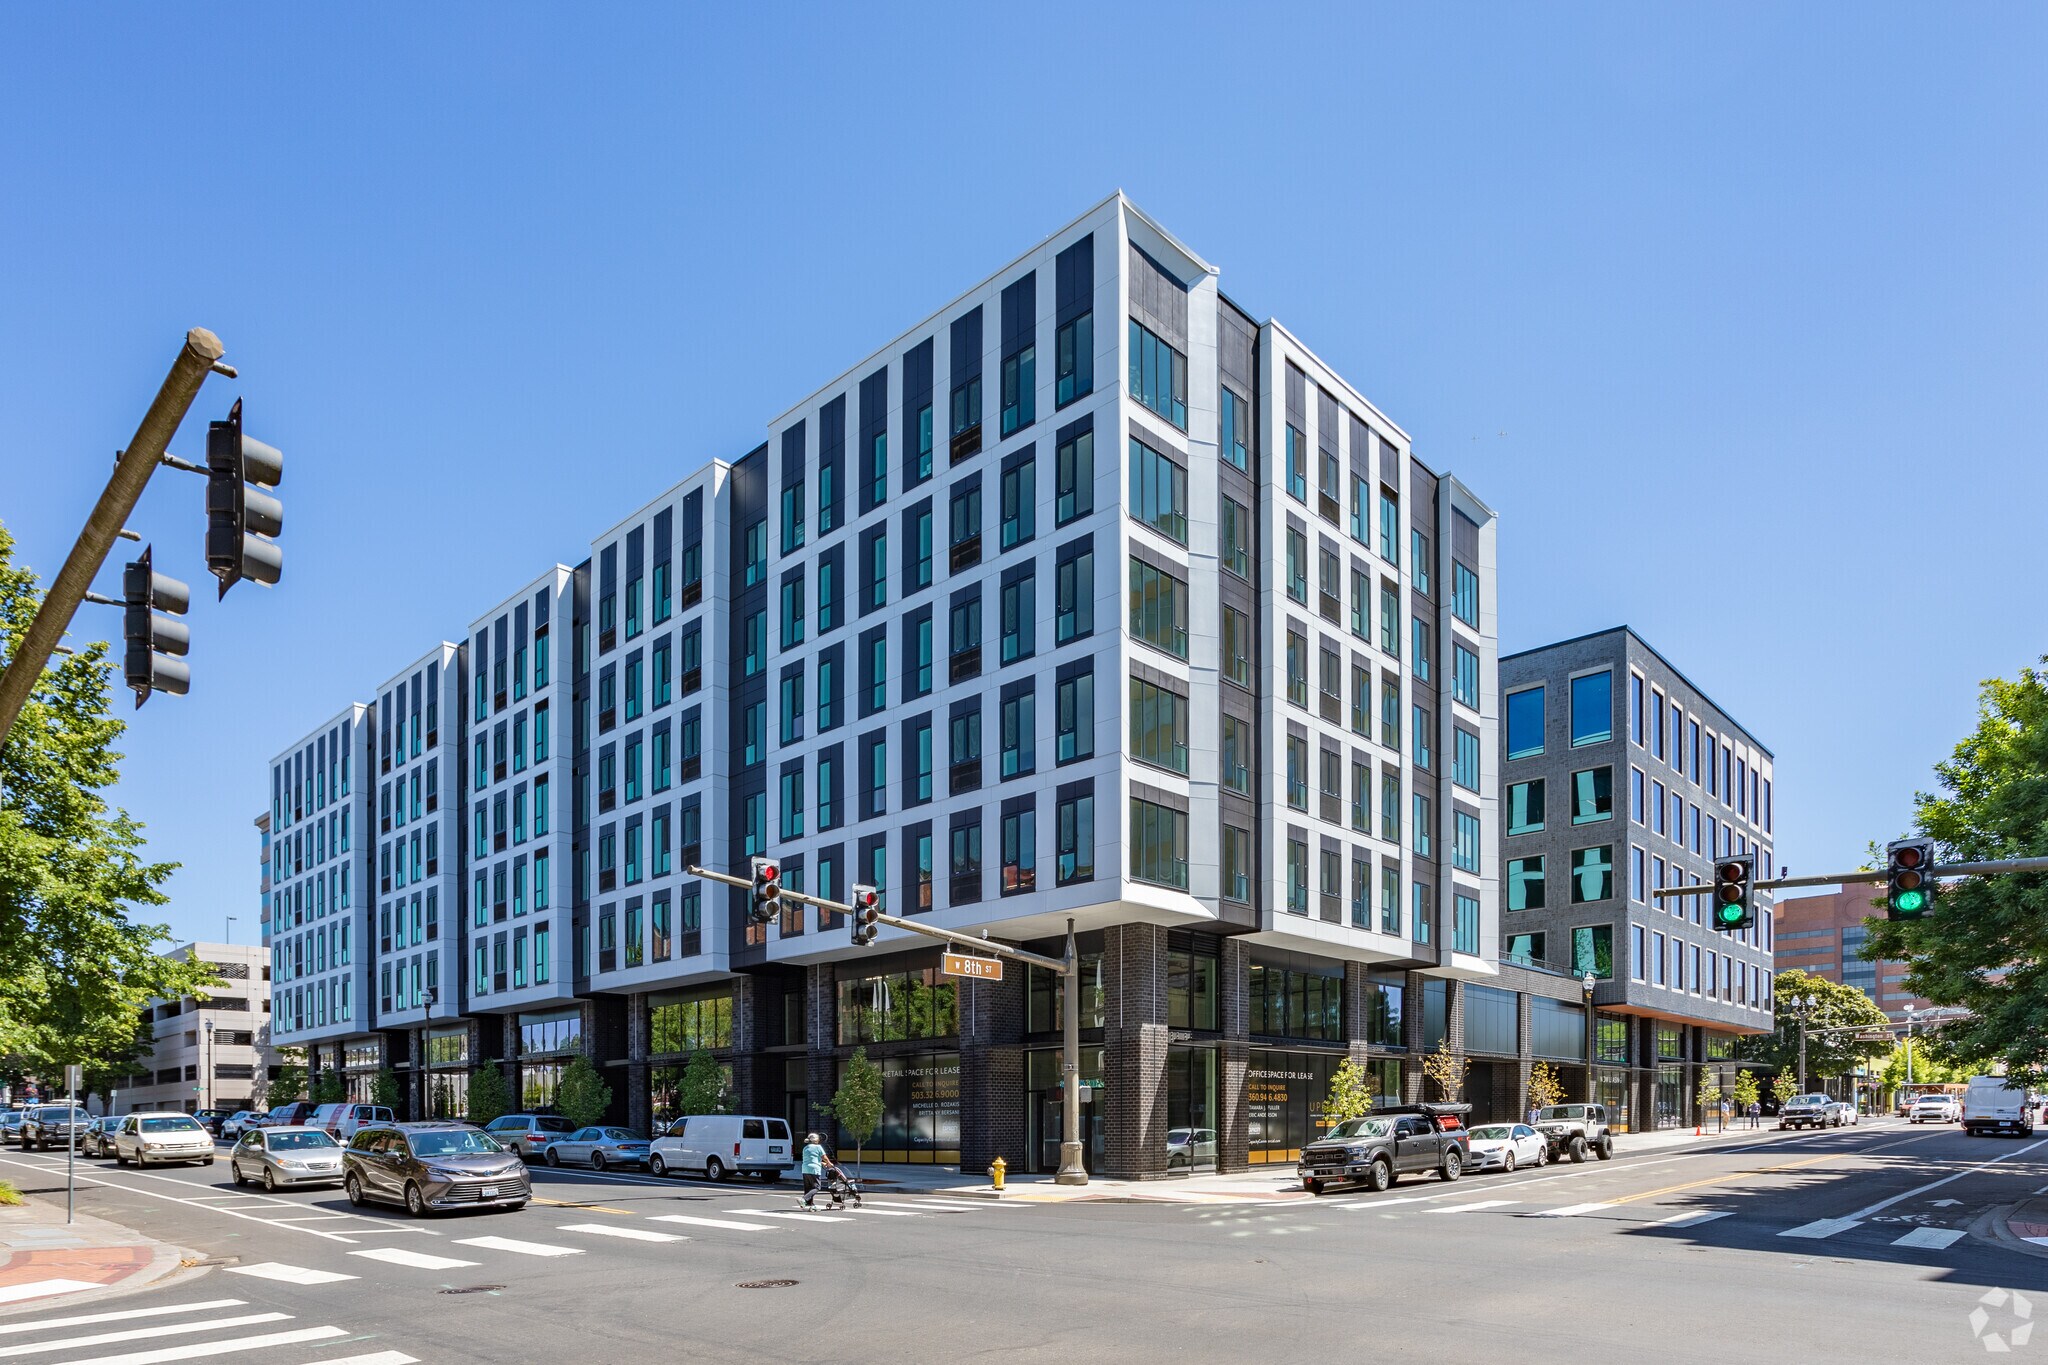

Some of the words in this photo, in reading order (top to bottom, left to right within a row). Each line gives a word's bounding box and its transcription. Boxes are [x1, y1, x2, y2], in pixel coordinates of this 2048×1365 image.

[955, 961, 960, 969] W
[964, 960, 982, 975] 8th
[985, 965, 992, 973] ST
[883, 1070, 904, 1078] RETAIL
[925, 1067, 939, 1076] FOR
[940, 1066, 960, 1075] LEASE
[1248, 1070, 1267, 1078] OFFICE
[1268, 1070, 1284, 1078] SPACE
[1284, 1071, 1296, 1079] FOR
[1297, 1072, 1313, 1080] LEASE
[935, 1080, 959, 1088] INQUIRE
[1268, 1084, 1286, 1092] INQUIRE
